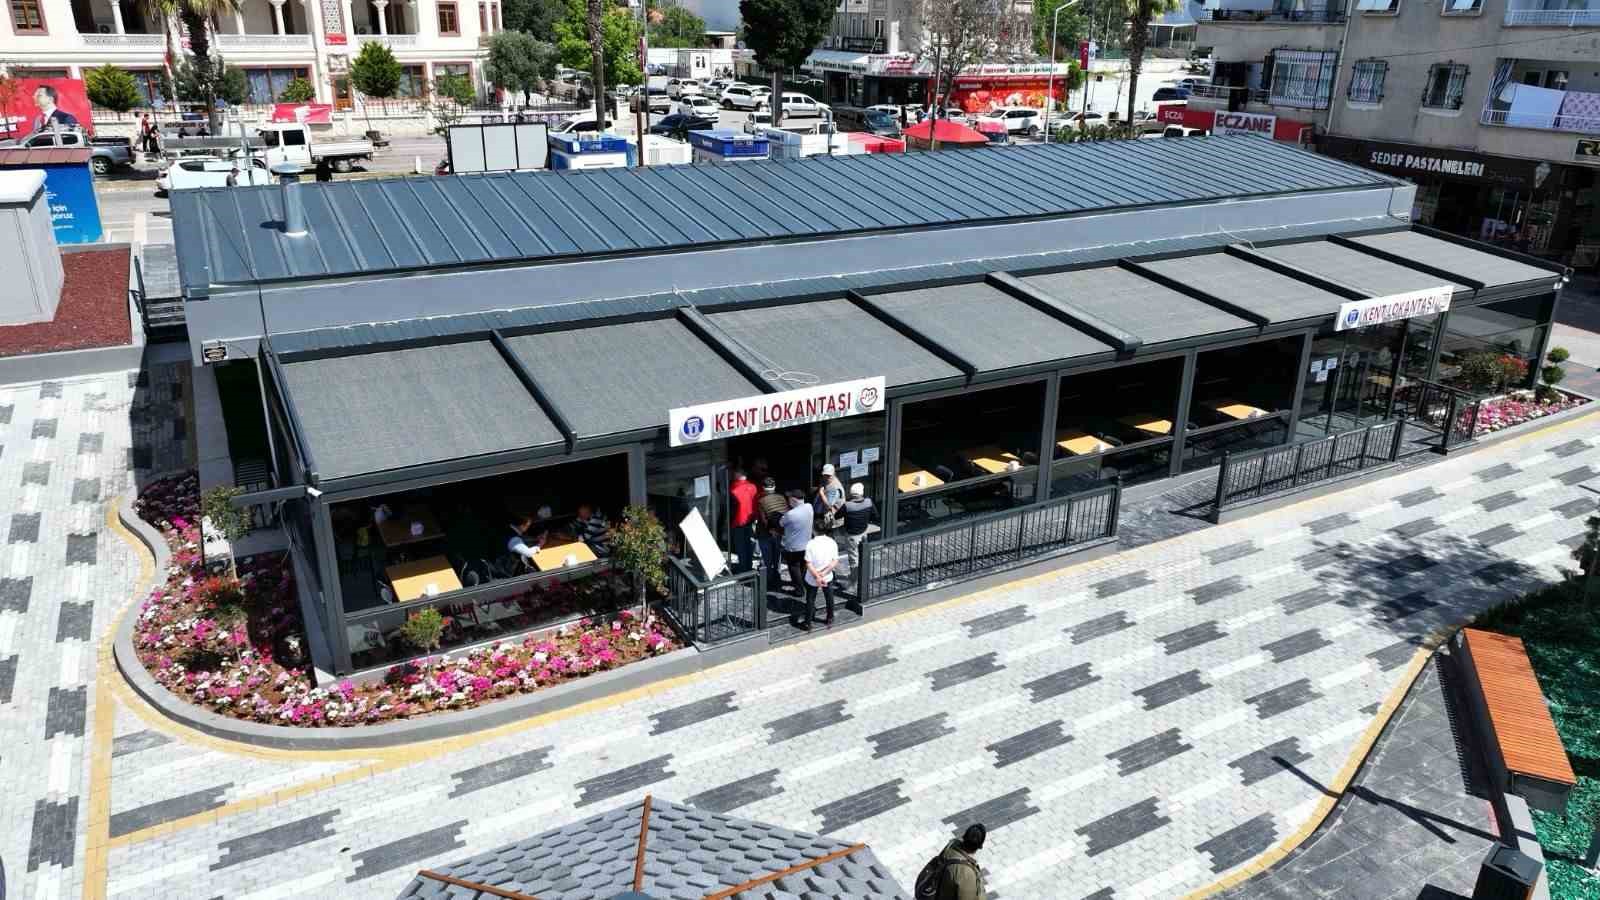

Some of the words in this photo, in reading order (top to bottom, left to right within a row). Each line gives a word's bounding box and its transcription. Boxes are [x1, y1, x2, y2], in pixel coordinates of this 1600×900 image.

[1164, 110, 1184, 121] ECZA
[1216, 114, 1272, 133] ECZANE
[1371, 151, 1404, 166] SEDEF
[1363, 304, 1386, 321] KENT
[1387, 296, 1436, 316] LOKANTASI
[715, 408, 758, 432] KENT
[763, 392, 851, 423] LOKANTASI
